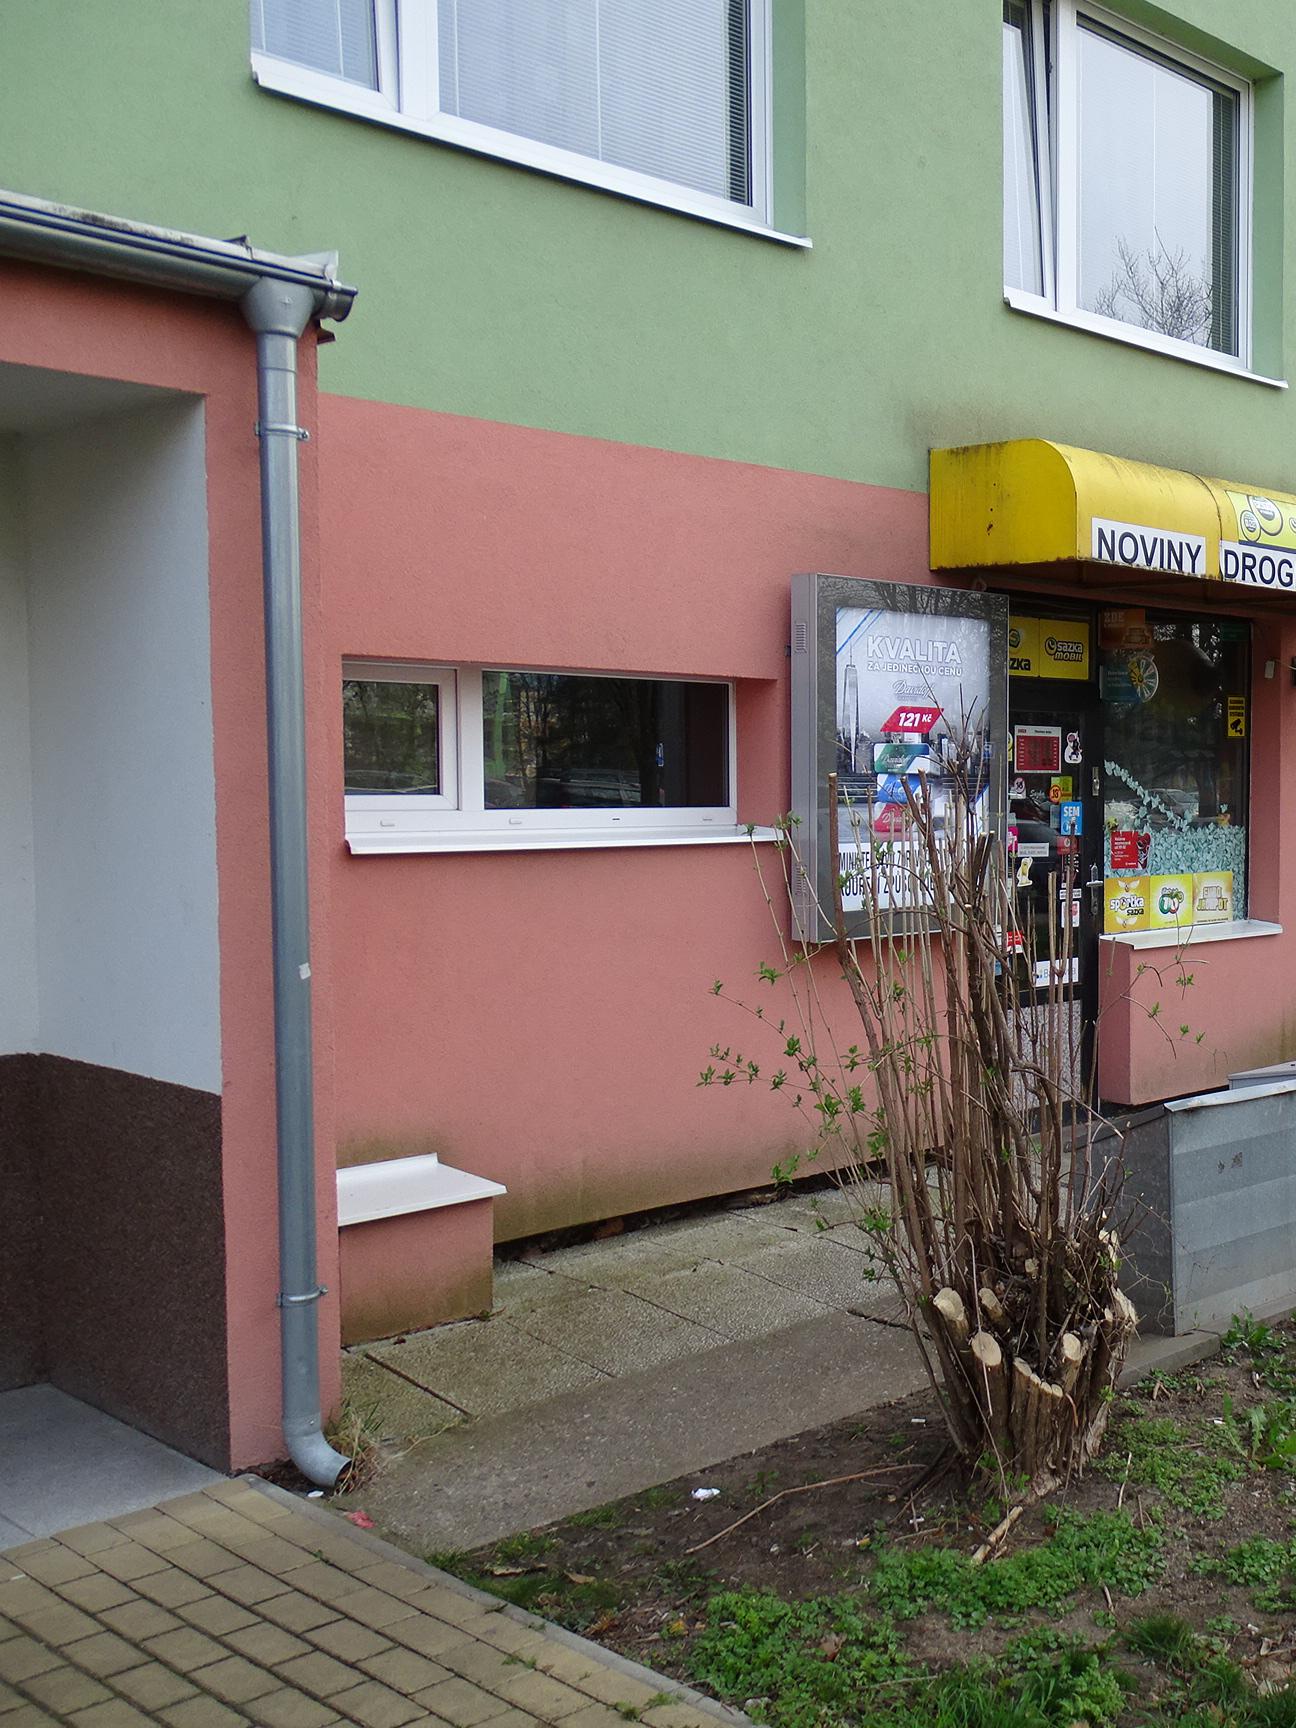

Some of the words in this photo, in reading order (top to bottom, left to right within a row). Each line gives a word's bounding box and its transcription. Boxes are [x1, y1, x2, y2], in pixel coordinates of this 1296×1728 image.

[1097, 527, 1202, 574] NOVINY
[867, 635, 962, 664] KVALITA
[1056, 640, 1083, 653] sazka
[867, 661, 880, 671] ZA
[938, 666, 962, 676] CENU
[898, 712, 921, 727] 121
[921, 714, 932, 723] Kč
[1063, 806, 1080, 817] SEM
[1110, 894, 1145, 912] sportka
